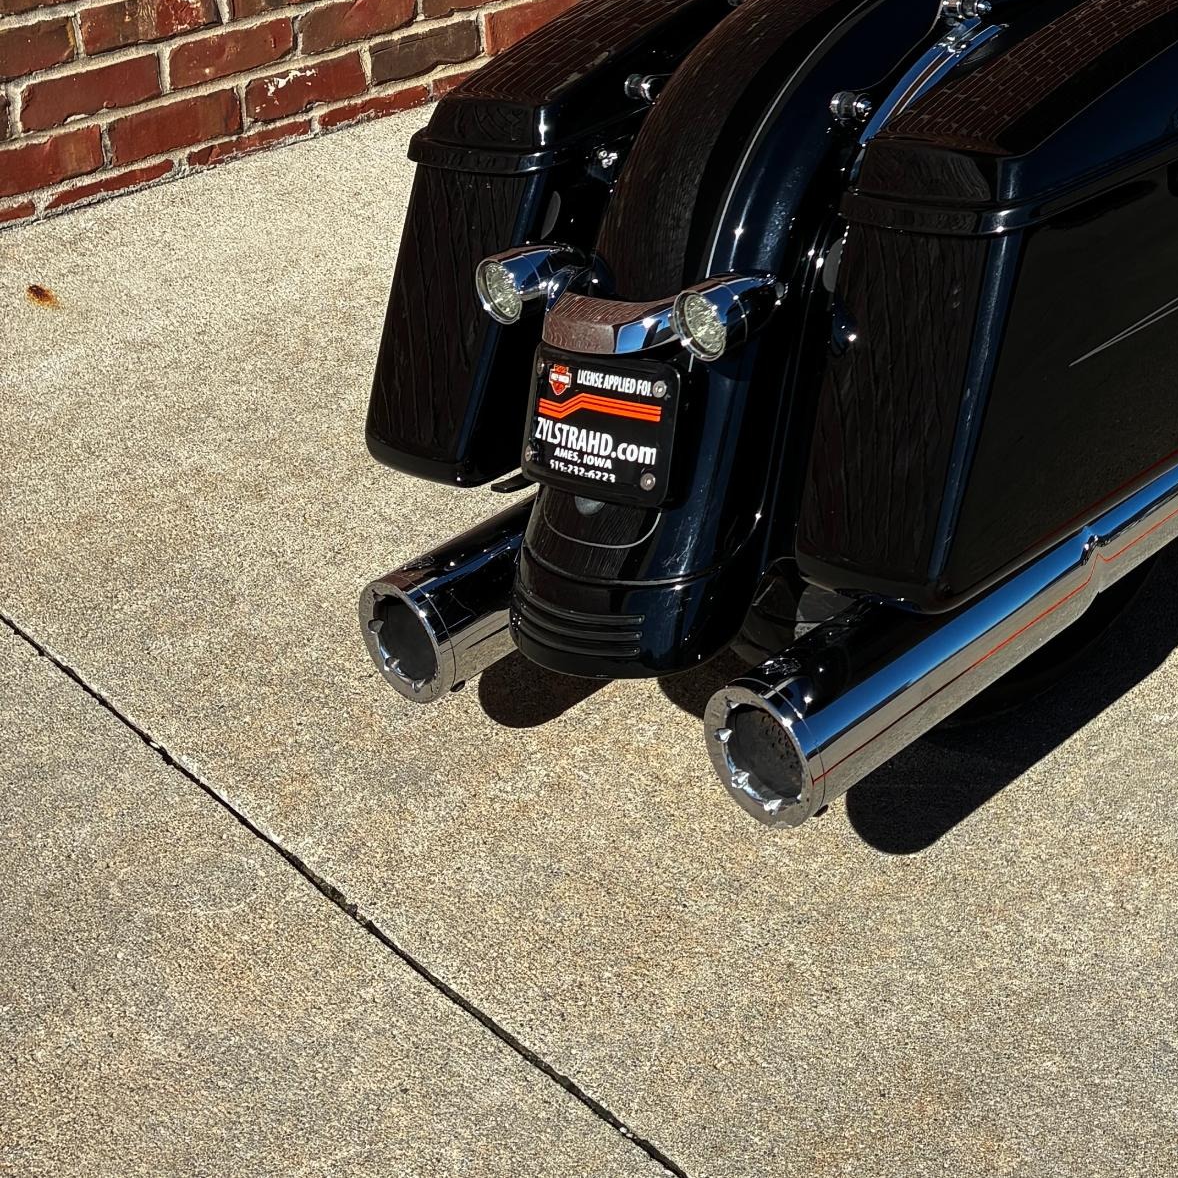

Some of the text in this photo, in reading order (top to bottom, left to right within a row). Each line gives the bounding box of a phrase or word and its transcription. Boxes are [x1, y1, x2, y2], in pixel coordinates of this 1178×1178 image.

[577, 369, 604, 388] LICENSE
[604, 375, 636, 394] APPLIED
[535, 417, 657, 465] ZYLSTRAHD.com
[554, 447, 613, 469] AMES, IOWA
